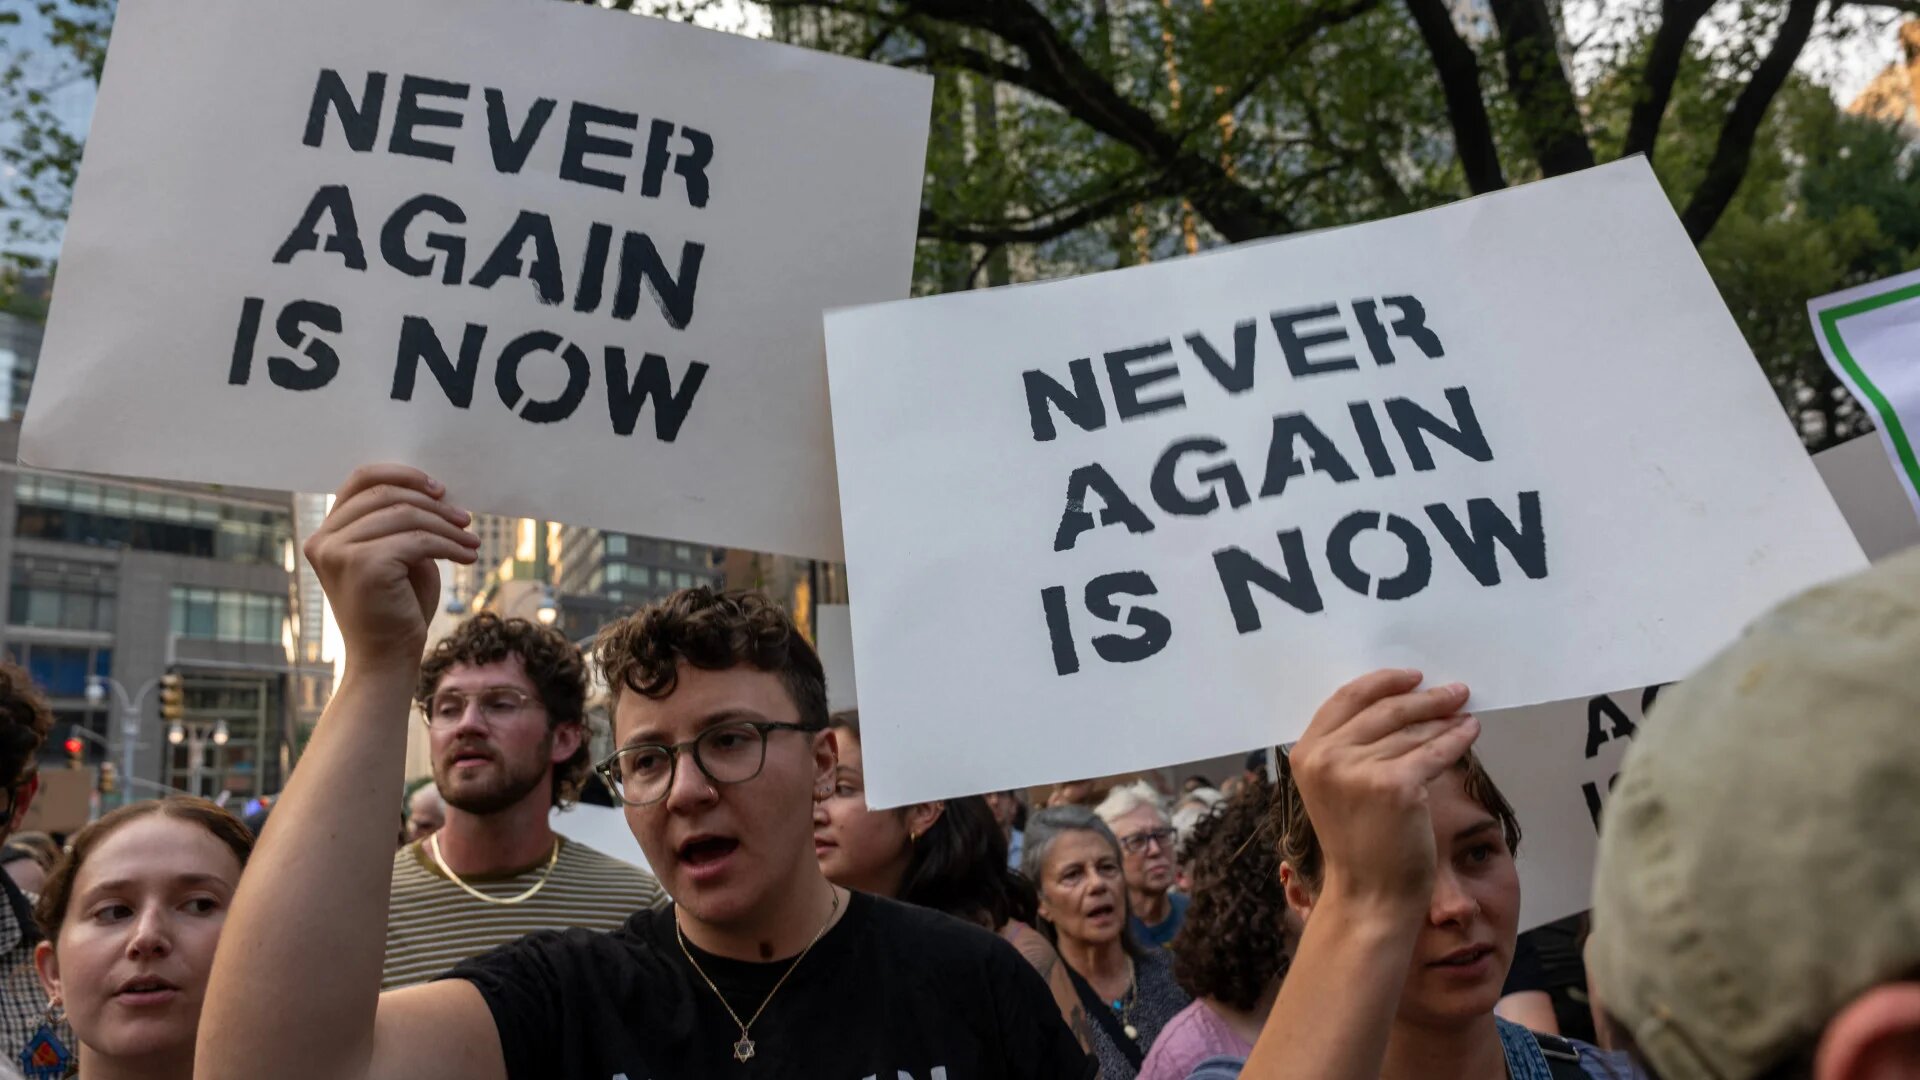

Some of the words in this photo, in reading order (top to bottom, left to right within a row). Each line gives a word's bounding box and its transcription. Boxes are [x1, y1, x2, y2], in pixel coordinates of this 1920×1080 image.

[303, 69, 714, 209] NEVER
[272, 185, 705, 330] AGAIN
[228, 297, 343, 392] IS
[390, 316, 710, 443] NOW
[1023, 295, 1445, 442] NEVER
[1054, 386, 1494, 553] AGAIN
[1041, 570, 1172, 676] IS
[1213, 490, 1548, 635] NOW
